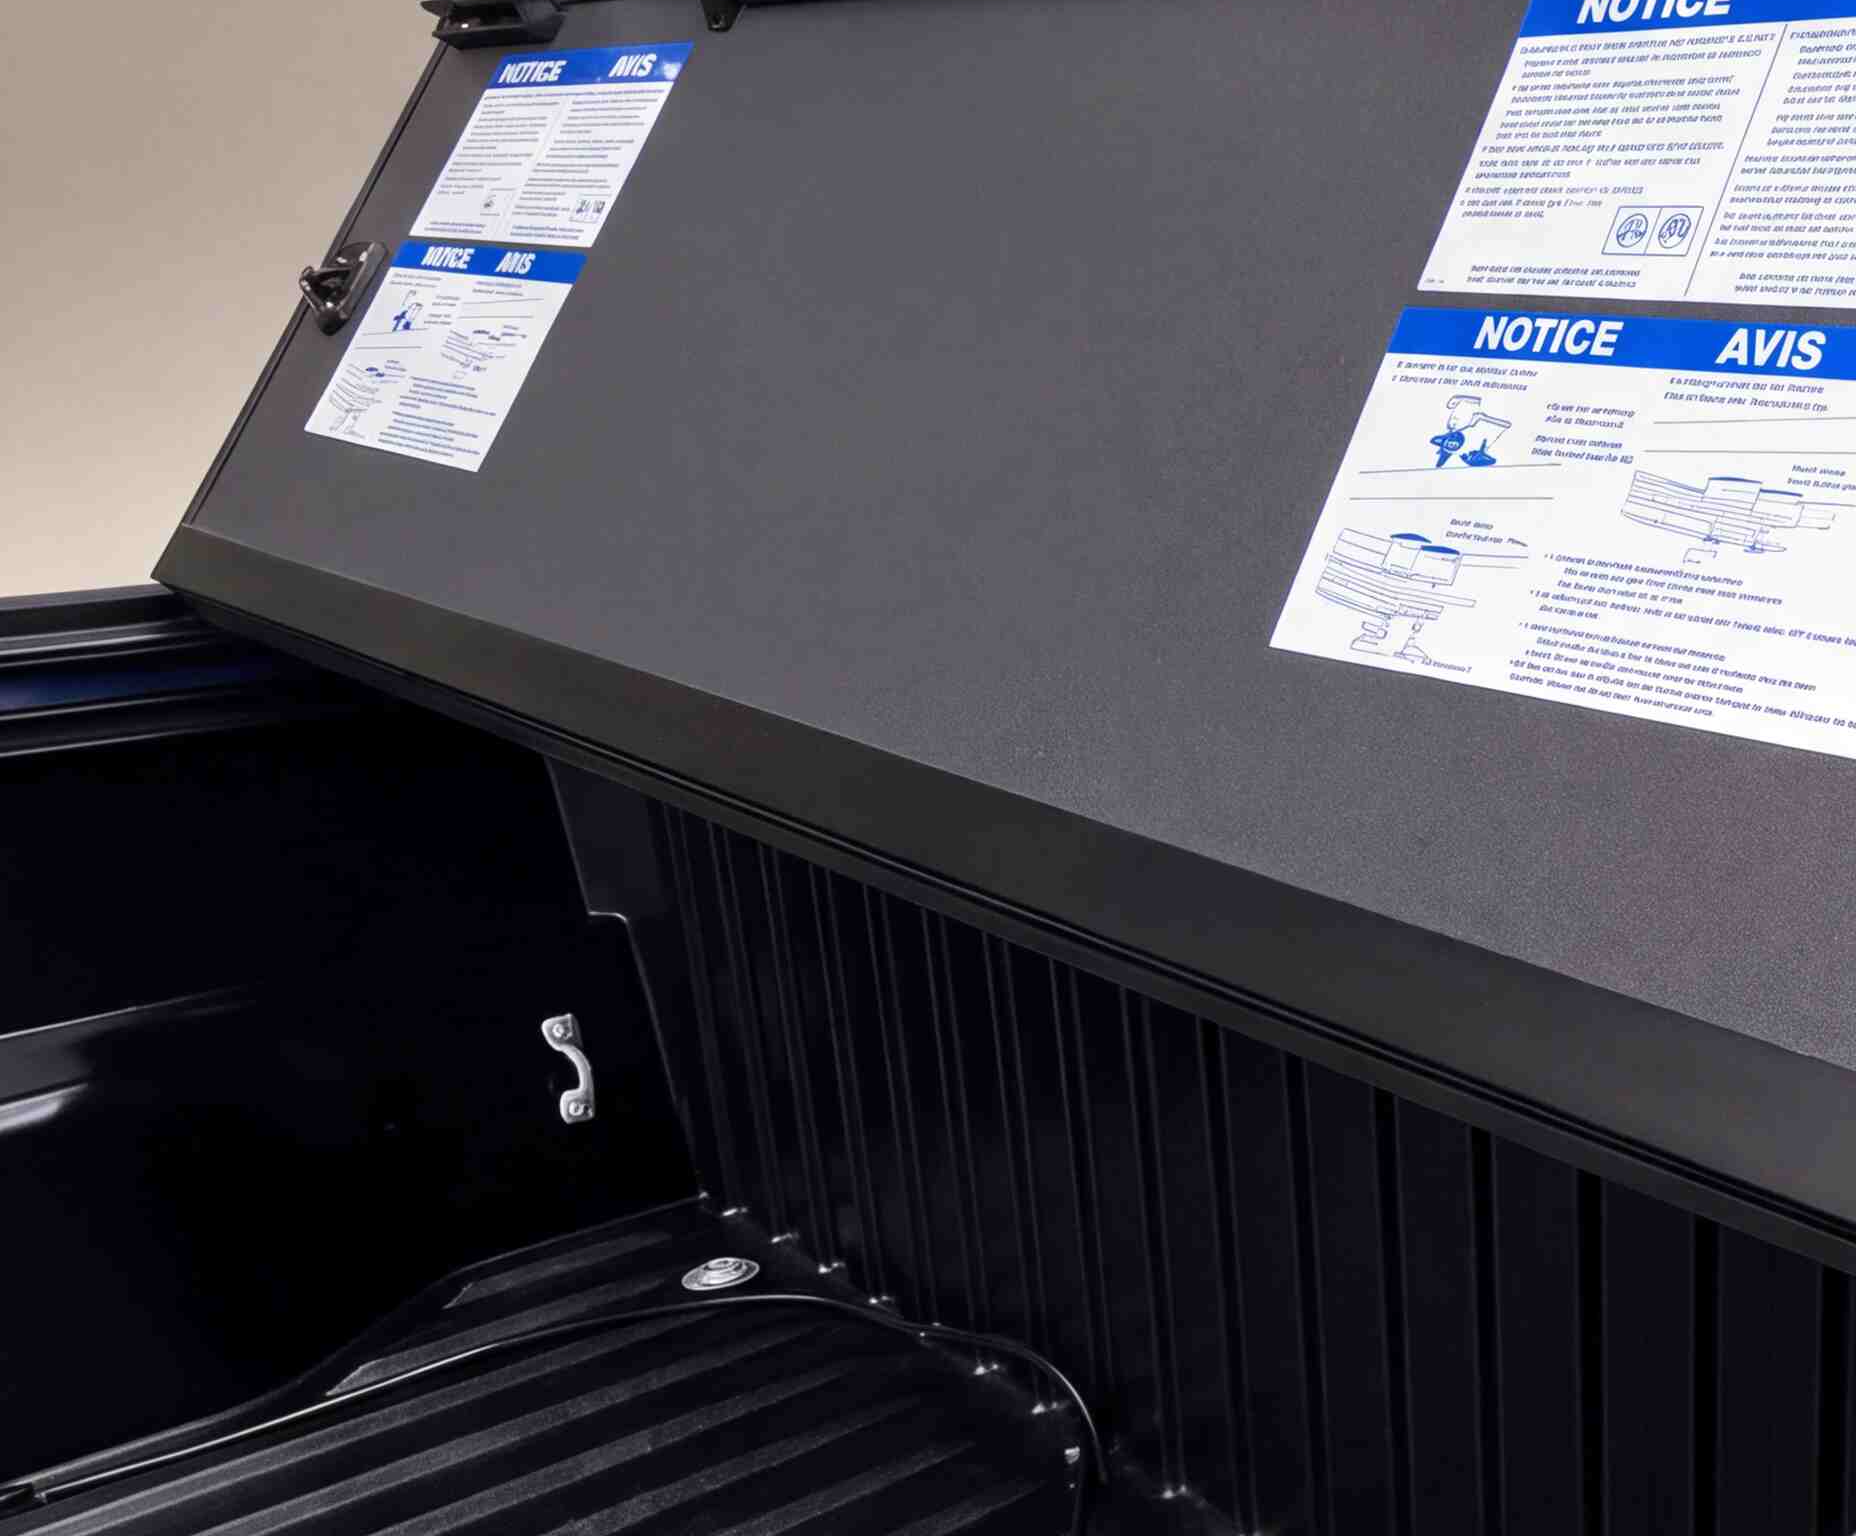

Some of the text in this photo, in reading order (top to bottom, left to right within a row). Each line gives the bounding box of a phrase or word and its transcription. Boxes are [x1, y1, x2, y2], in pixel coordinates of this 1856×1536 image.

[498, 53, 657, 84] NOTICE AVIS
[1473, 316, 1826, 370] NOTICE AVIS
